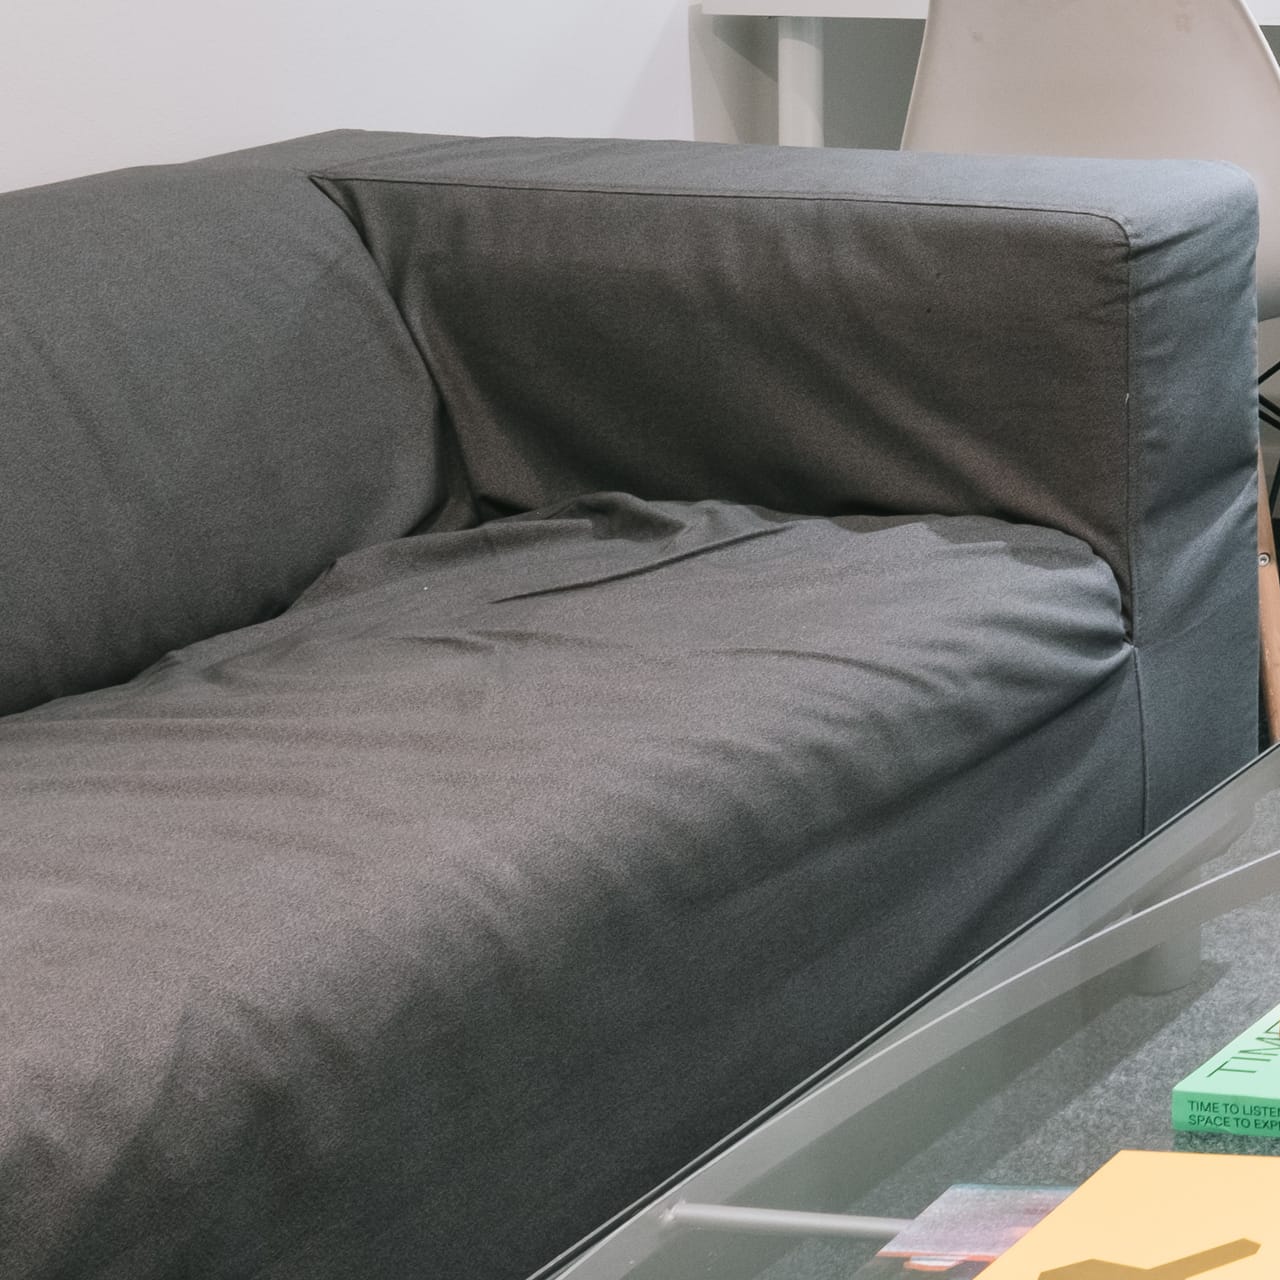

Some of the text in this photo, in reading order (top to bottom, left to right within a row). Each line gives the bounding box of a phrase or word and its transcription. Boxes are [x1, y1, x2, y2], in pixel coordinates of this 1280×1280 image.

[1188, 1100, 1219, 1114] TIME
[1222, 1103, 1239, 1115] TO
[1188, 1114, 1231, 1127] SPACE
[1234, 1117, 1251, 1129] TO
